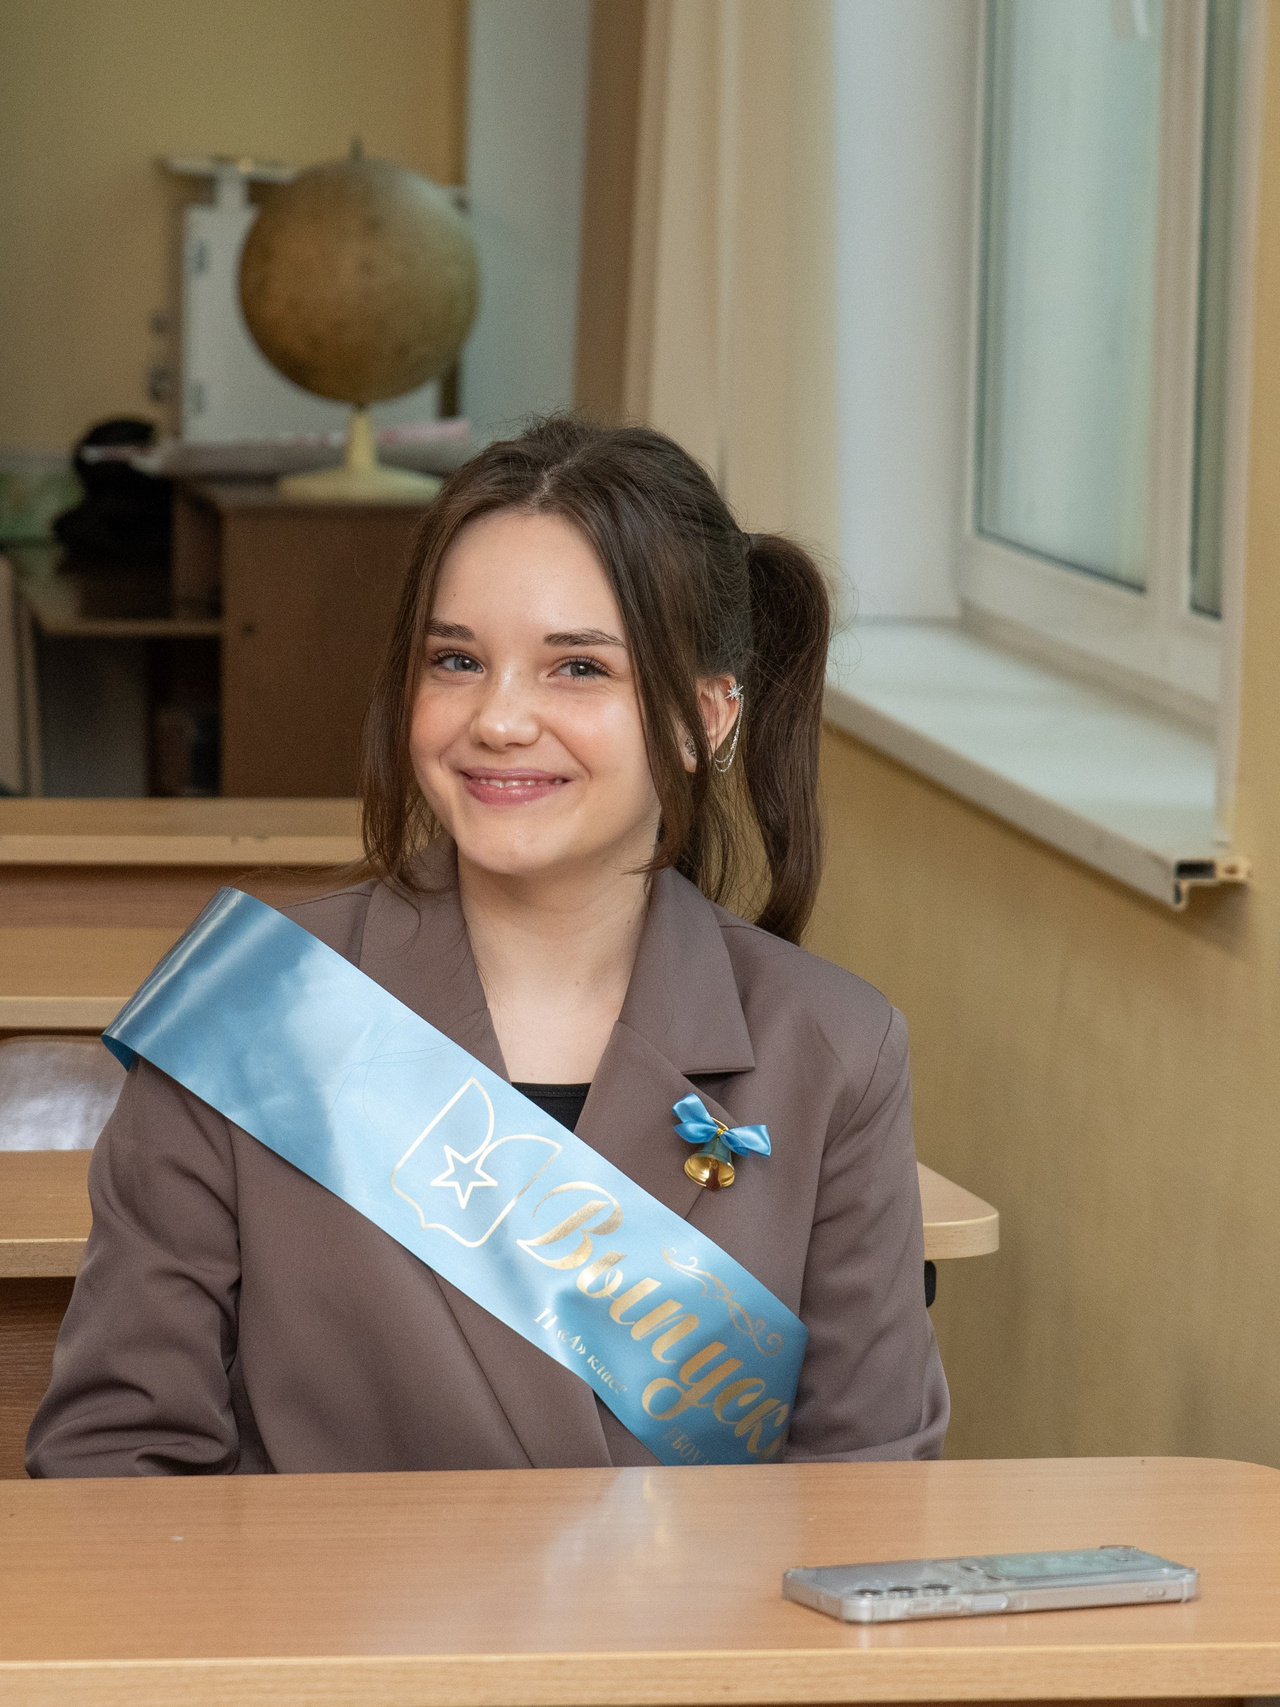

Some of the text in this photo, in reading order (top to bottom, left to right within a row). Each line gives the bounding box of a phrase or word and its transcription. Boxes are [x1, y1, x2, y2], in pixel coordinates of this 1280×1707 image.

[516, 1181, 790, 1464] Выпуск
[534, 1307, 559, 1330] 11
[586, 1354, 628, 1395] класс
